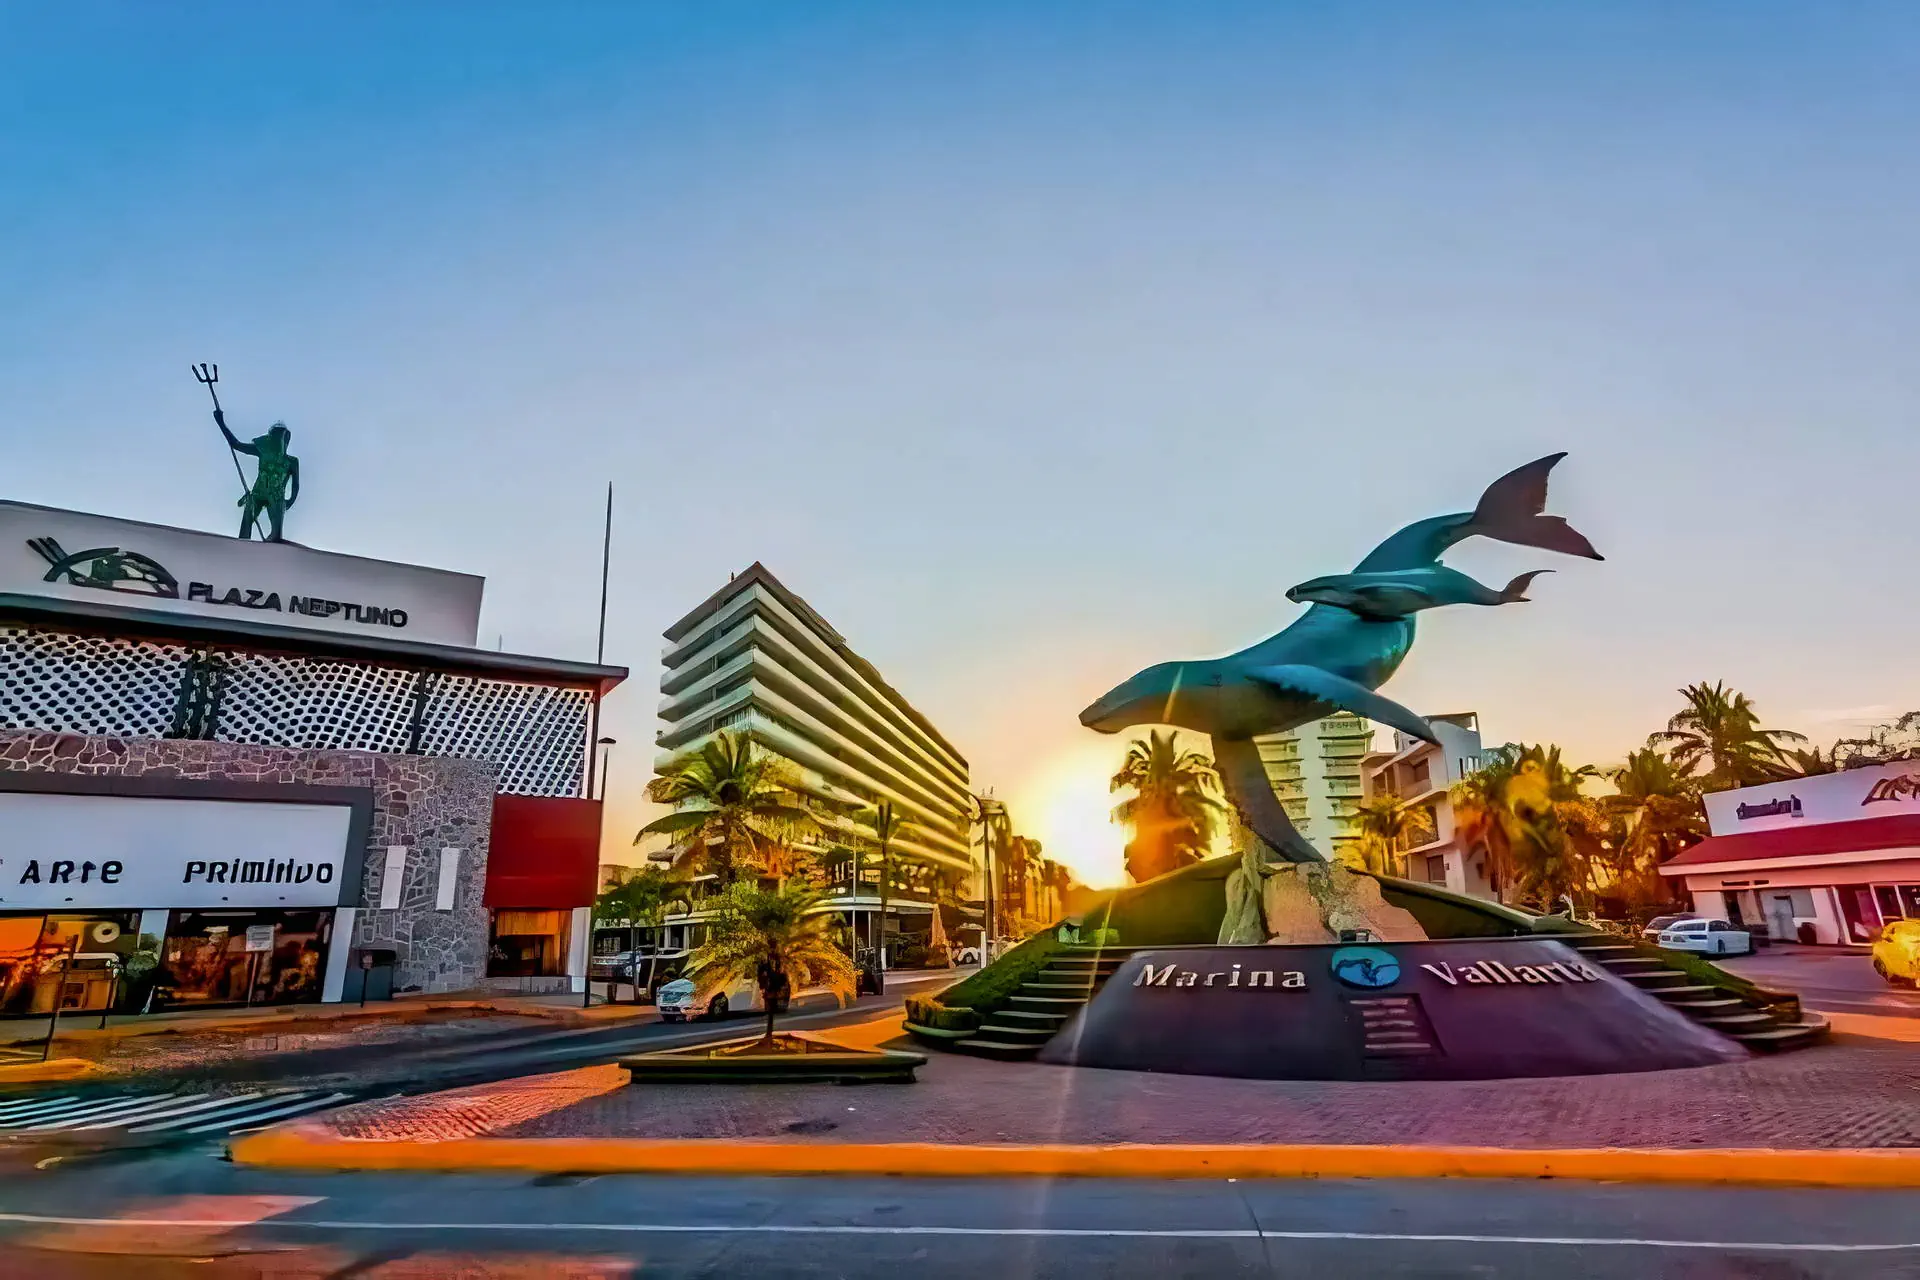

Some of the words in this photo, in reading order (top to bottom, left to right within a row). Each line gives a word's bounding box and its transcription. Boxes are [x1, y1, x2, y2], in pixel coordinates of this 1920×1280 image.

[188, 581, 282, 612] PLAZA
[289, 595, 408, 628] NEPTUNO
[1132, 963, 1307, 989] Marina
[1419, 960, 1602, 986] Vallarta
